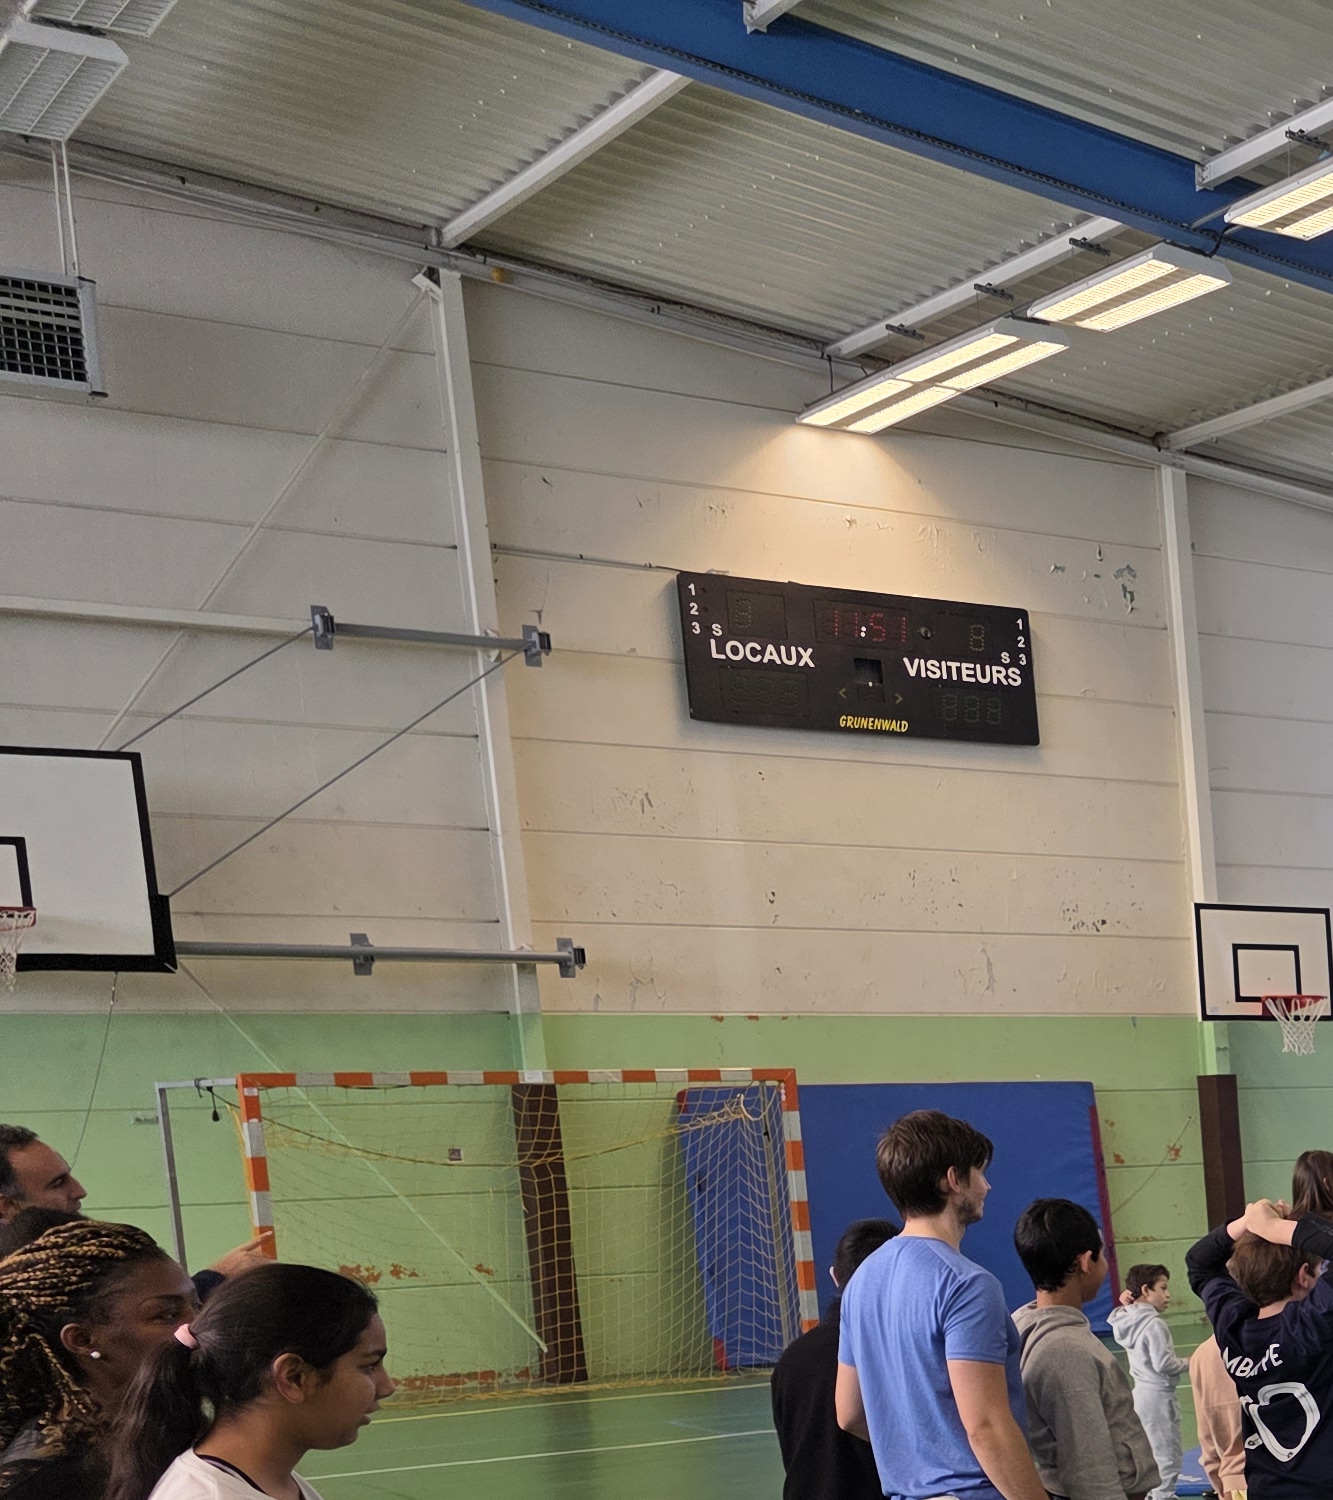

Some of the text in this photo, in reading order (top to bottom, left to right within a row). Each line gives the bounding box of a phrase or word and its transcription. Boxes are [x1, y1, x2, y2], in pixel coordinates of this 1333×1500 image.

[687, 582, 696, 596] 1
[689, 602, 699, 616] 2
[691, 621, 701, 635] 3
[1016, 618, 1024, 631] 1
[1017, 636, 1026, 648] 2
[709, 638, 816, 669] LOCAUX
[1018, 653, 1027, 666] 3
[903, 657, 1022, 687] VISITEURS
[839, 714, 909, 733] GRUNENWALD
